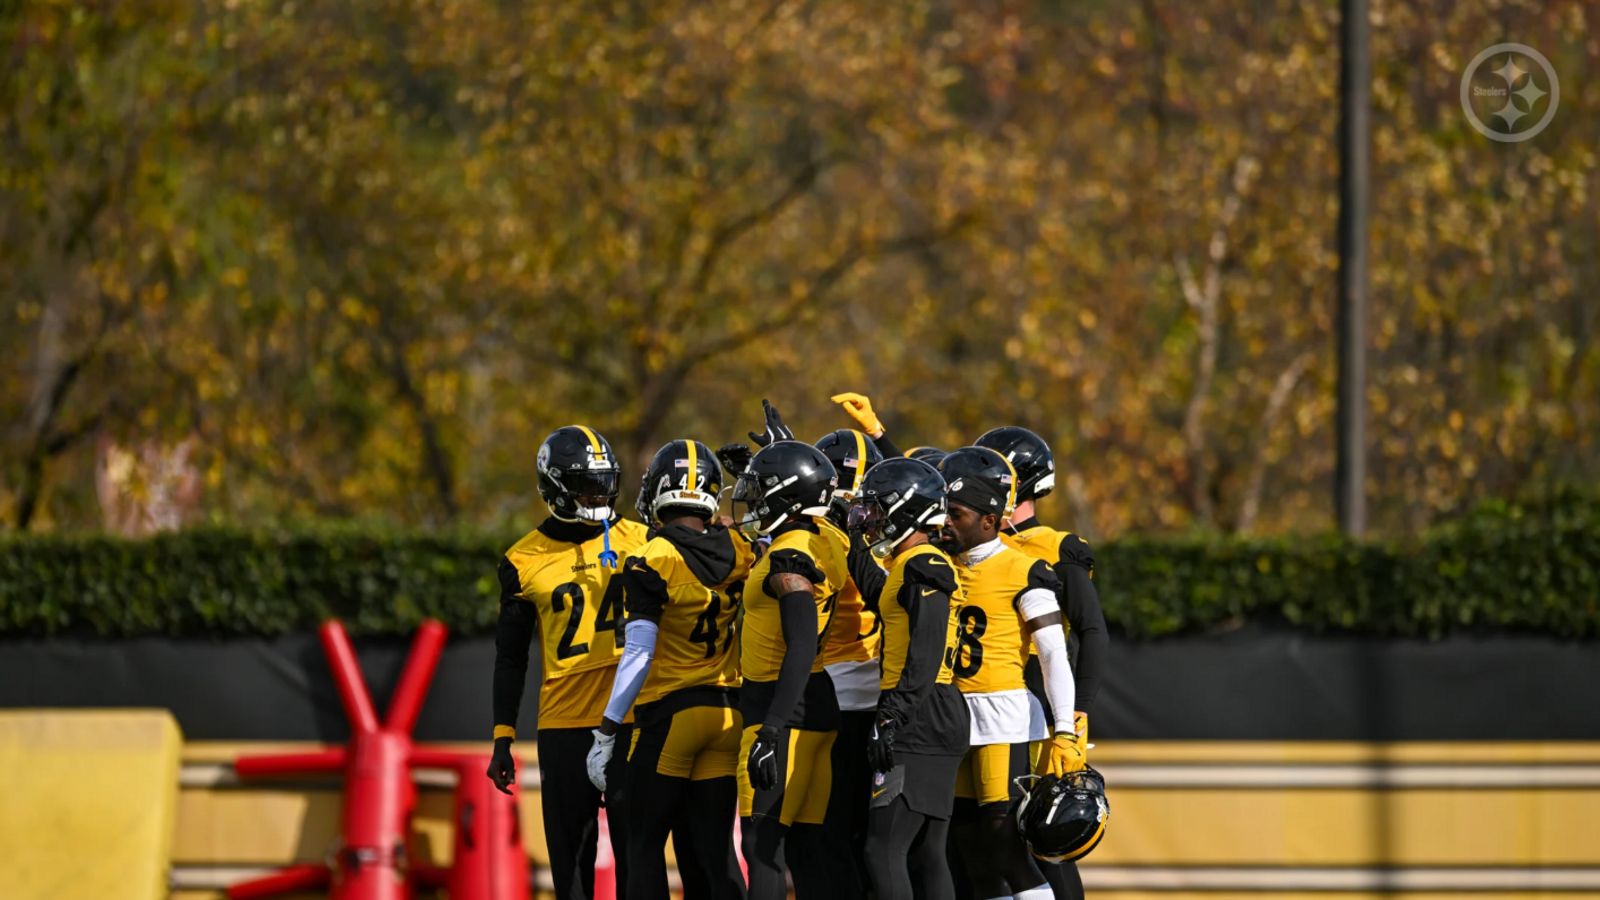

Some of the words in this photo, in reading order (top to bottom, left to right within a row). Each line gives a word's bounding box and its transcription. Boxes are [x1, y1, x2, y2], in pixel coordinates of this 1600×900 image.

[679, 473, 705, 491] 42
[571, 563, 597, 573] Steelers
[551, 574, 626, 661] 24
